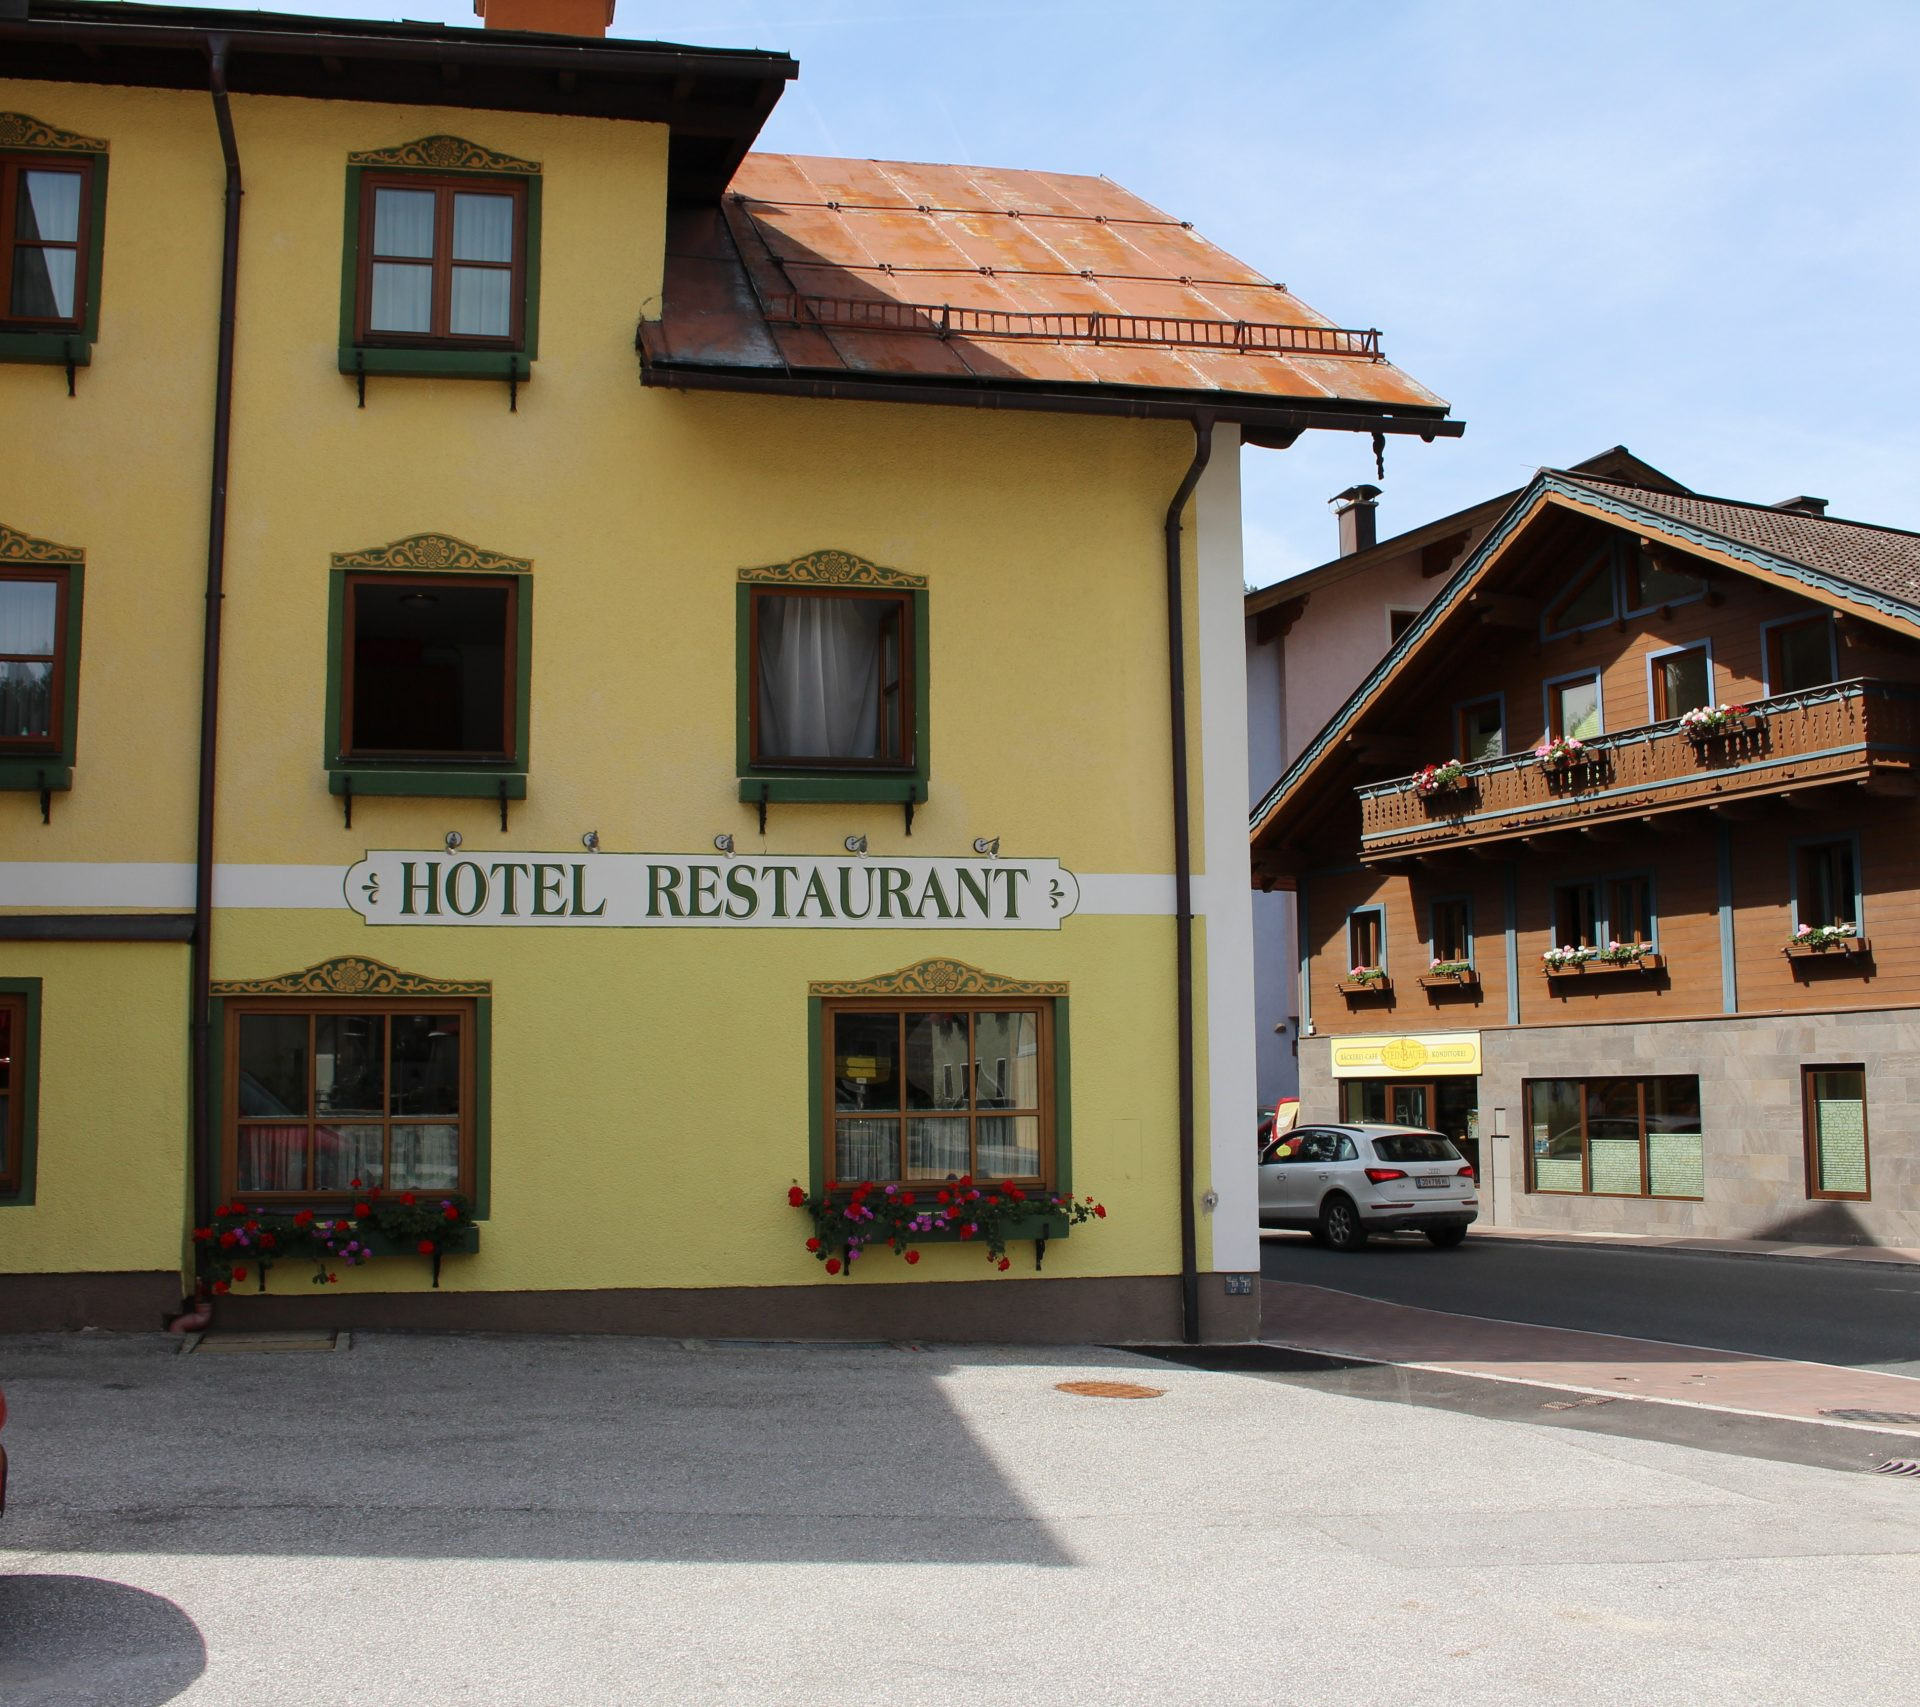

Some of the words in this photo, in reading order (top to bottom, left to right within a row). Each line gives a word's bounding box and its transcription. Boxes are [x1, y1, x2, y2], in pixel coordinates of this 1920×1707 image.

[402, 859, 606, 918] HOTEL
[646, 861, 1030, 920] RESTAURANT
[1431, 1050, 1467, 1058] KONDITOREI
